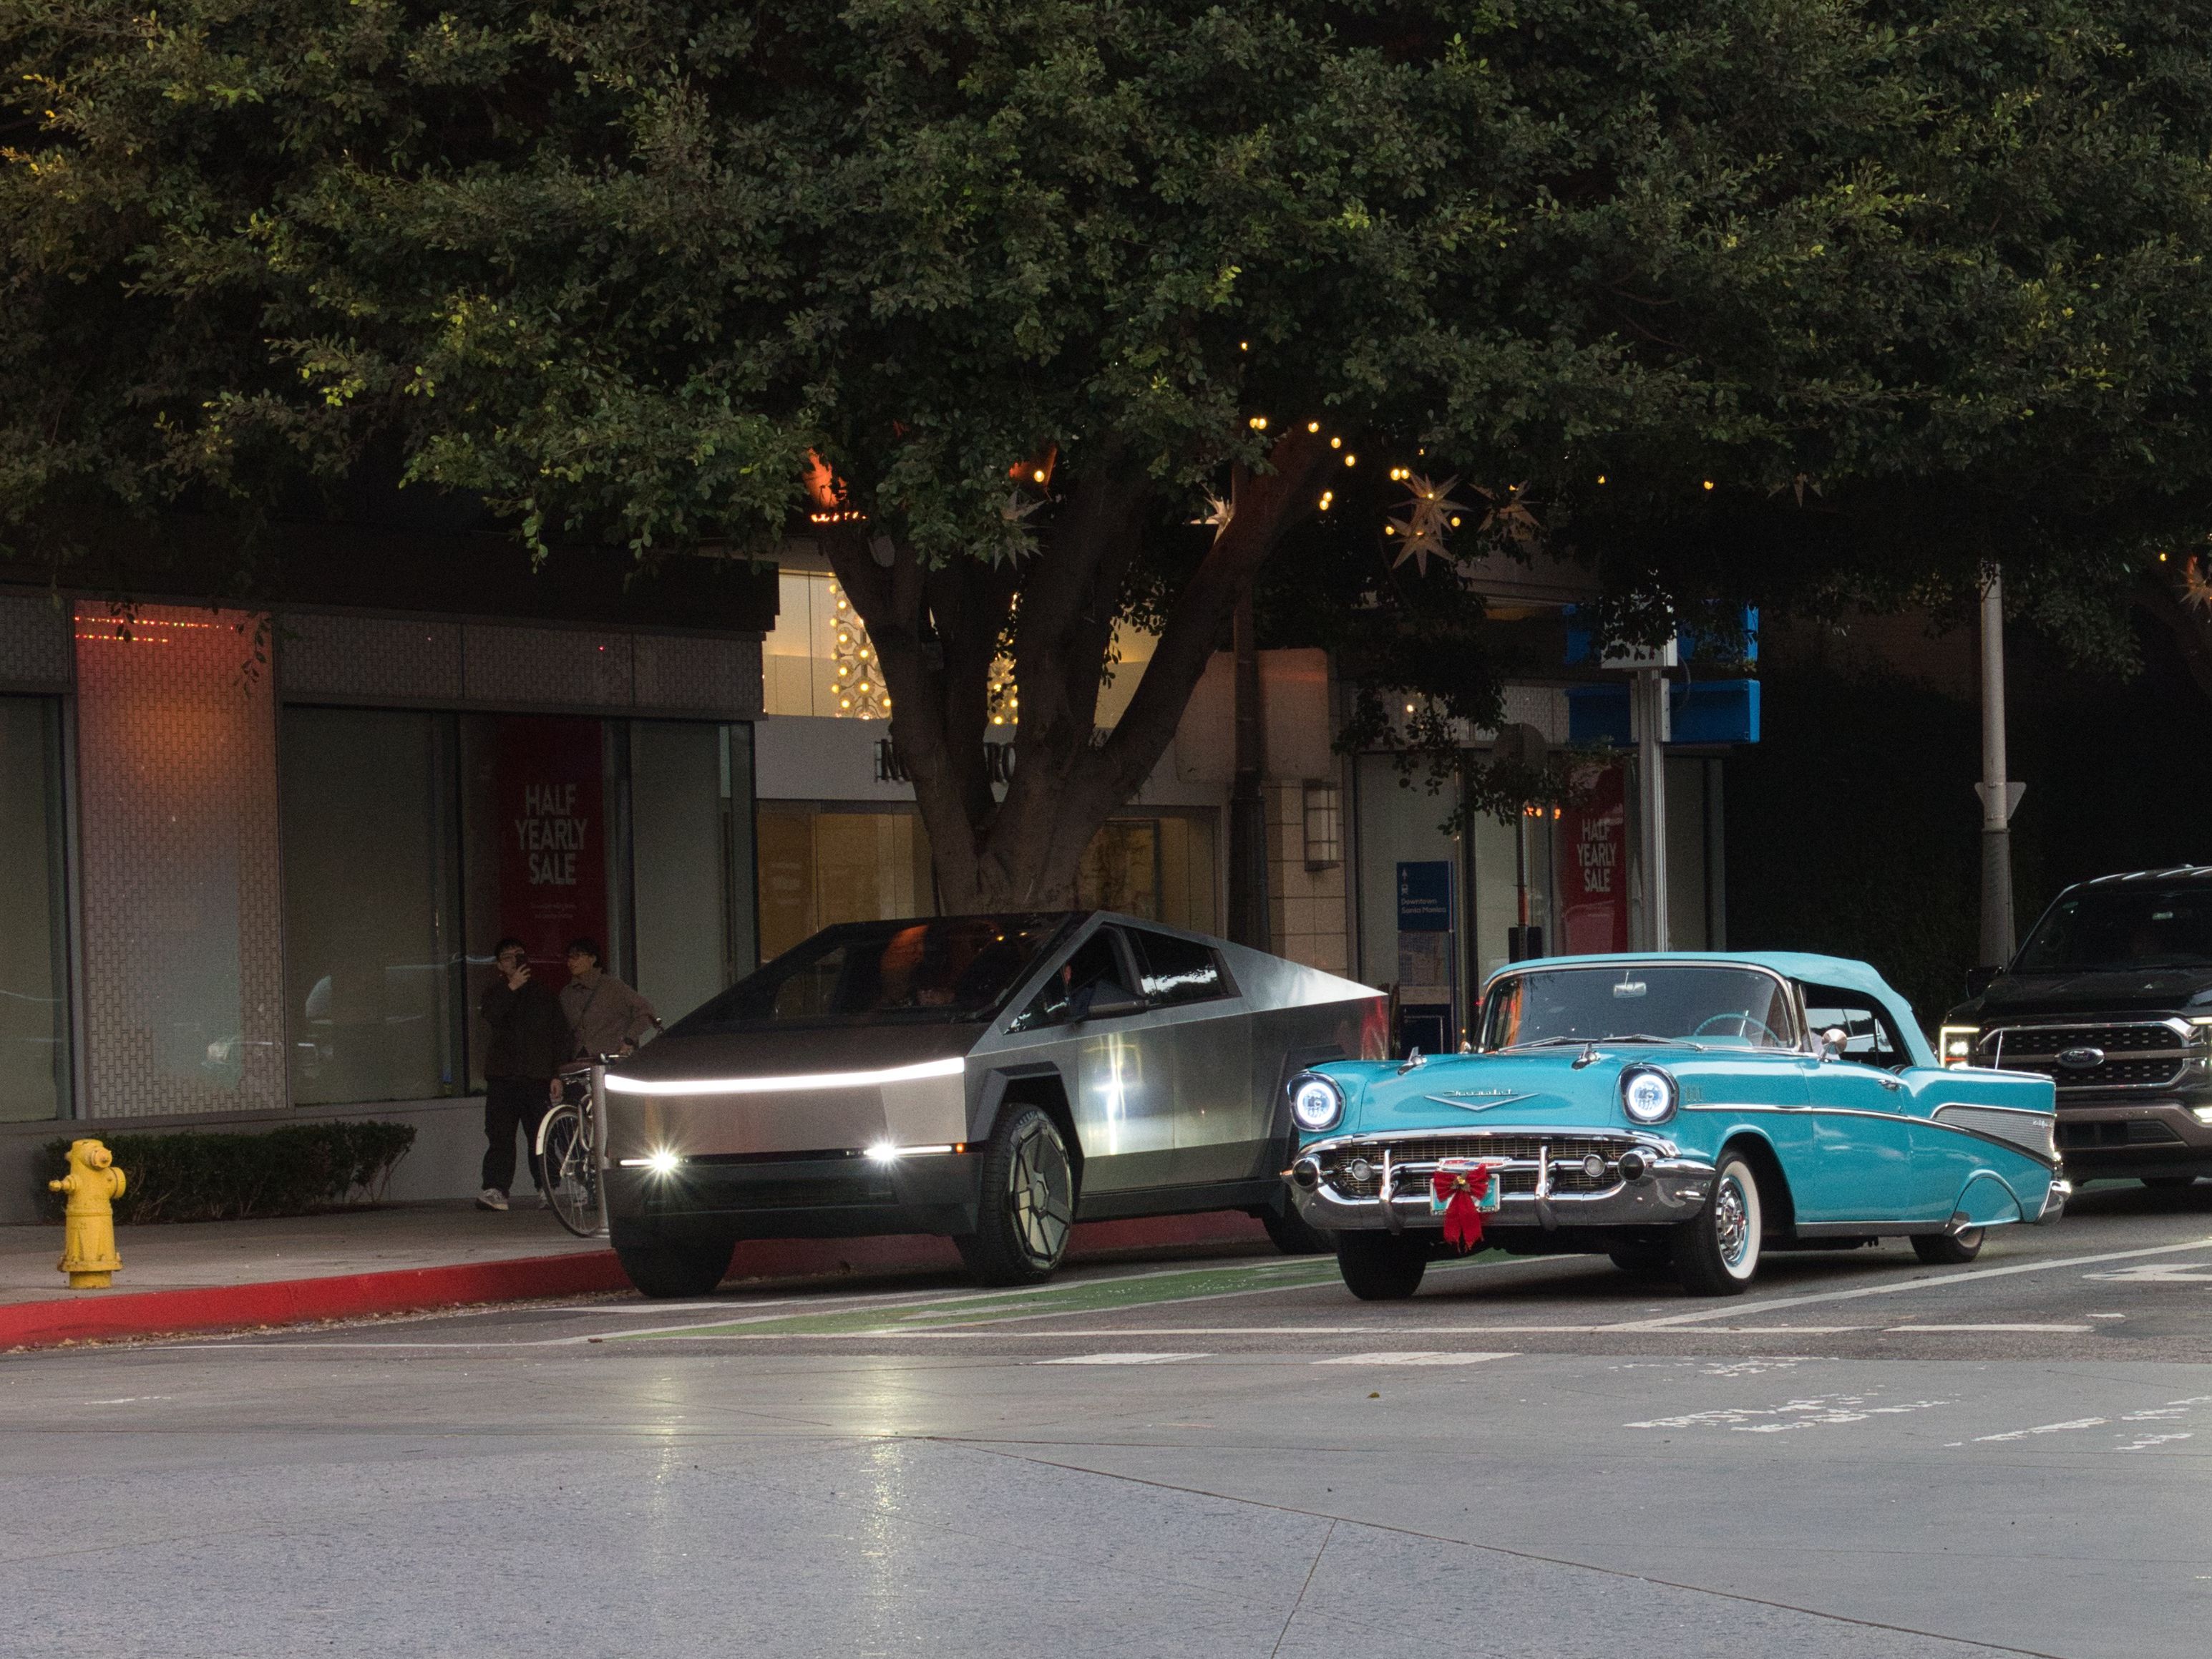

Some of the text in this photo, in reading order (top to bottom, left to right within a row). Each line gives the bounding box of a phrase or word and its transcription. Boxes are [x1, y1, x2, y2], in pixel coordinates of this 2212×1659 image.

[526, 784, 576, 815] HALF
[515, 818, 588, 850] YEARLY
[1582, 818, 1610, 841] HALF
[1577, 842, 1617, 867] YEARLY
[530, 853, 577, 885] SALE
[1584, 868, 1611, 892] SALE
